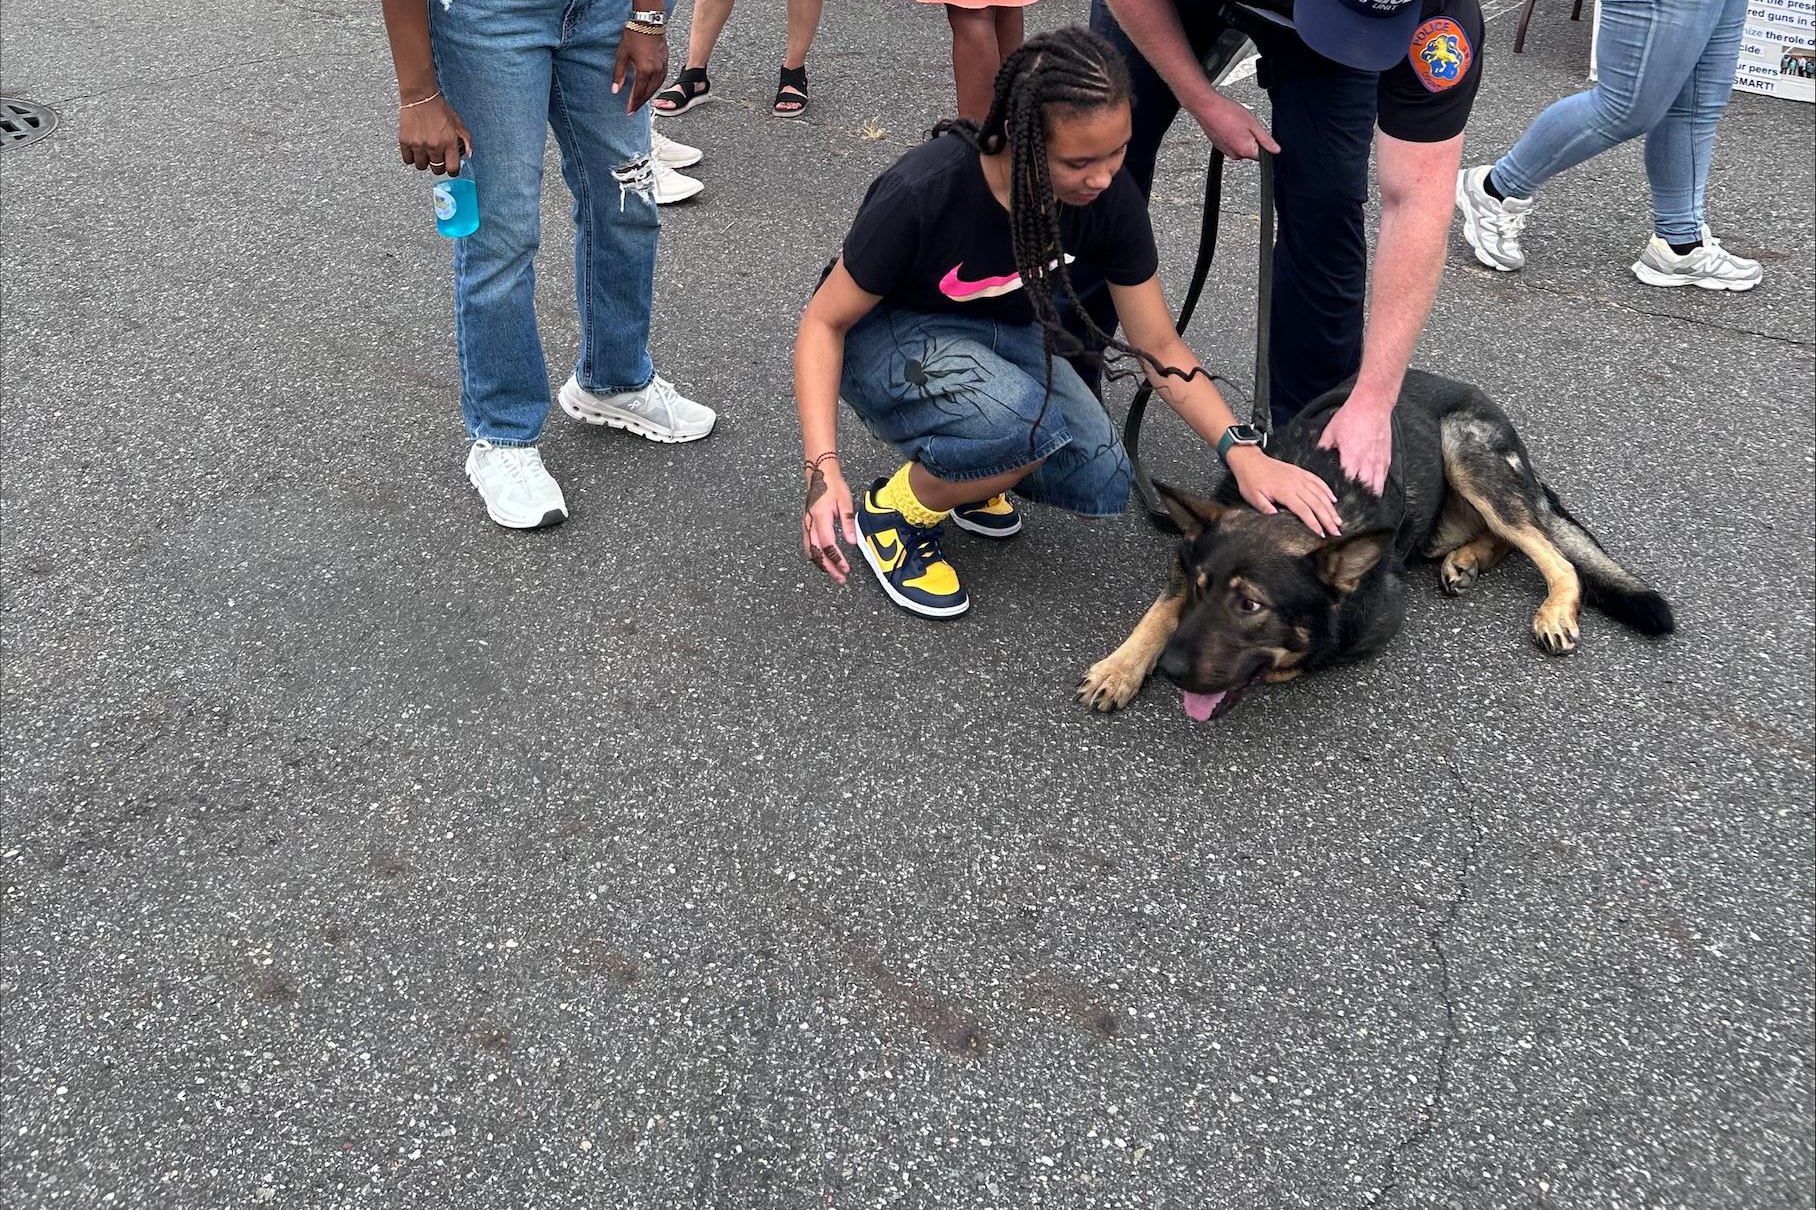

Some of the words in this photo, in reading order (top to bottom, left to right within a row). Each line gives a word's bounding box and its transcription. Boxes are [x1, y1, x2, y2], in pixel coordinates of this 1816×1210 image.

[1372, 2, 1399, 11] UNIT
[1748, 9, 1765, 18] red
[1768, 13, 1794, 23] guns
[1797, 15, 1807, 26] in
[1412, 21, 1450, 47] POLICE
[1749, 65, 1778, 76] peers
[1732, 76, 1774, 91] SMART!
